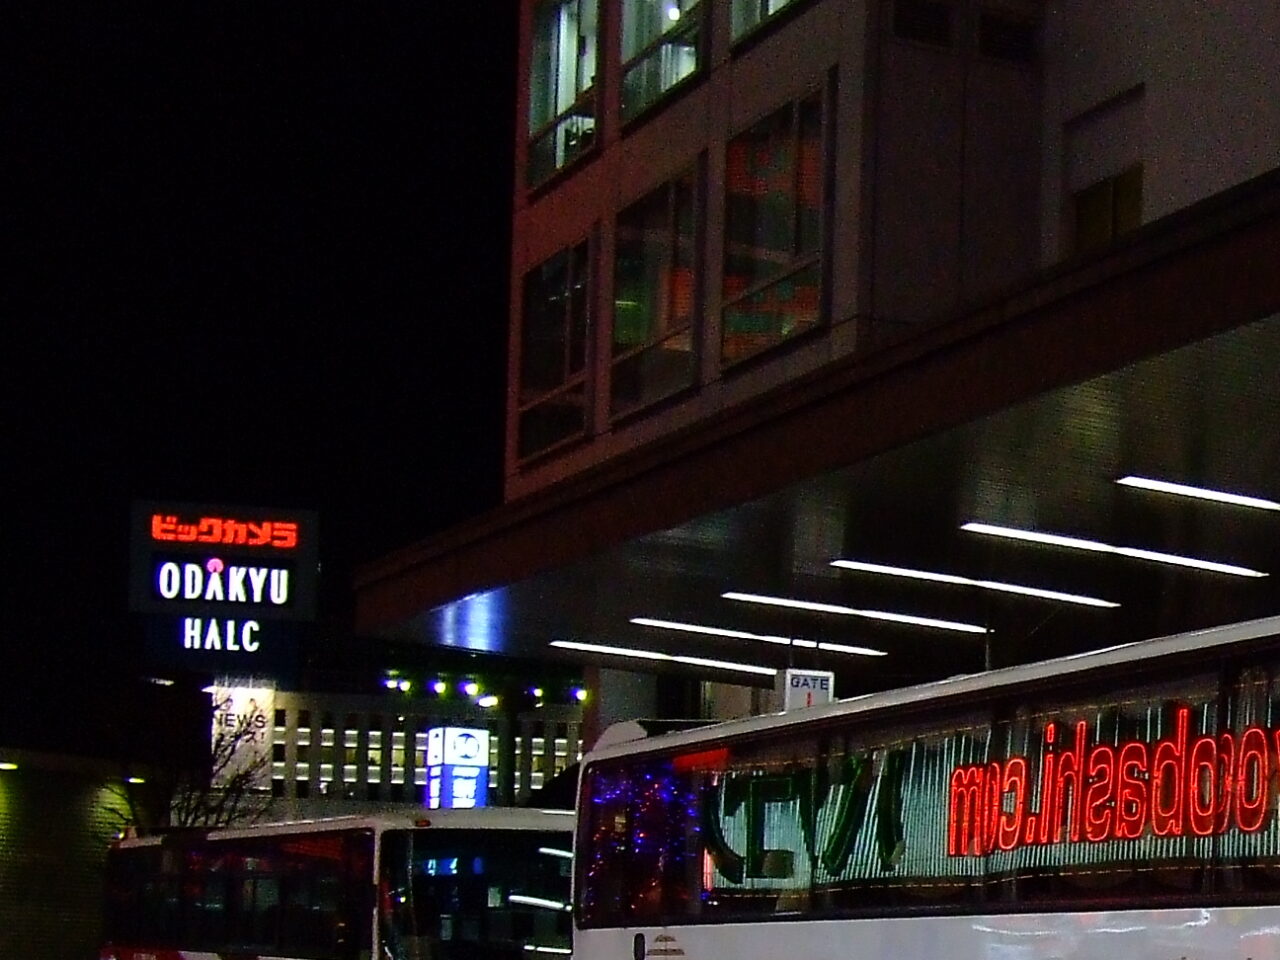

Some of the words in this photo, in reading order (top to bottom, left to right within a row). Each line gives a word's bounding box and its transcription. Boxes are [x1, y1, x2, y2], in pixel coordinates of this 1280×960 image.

[151, 514, 297, 548] ビックカメラ
[159, 558, 289, 605] ODAKYU
[184, 617, 260, 652] HALC
[791, 677, 829, 691] GATE
